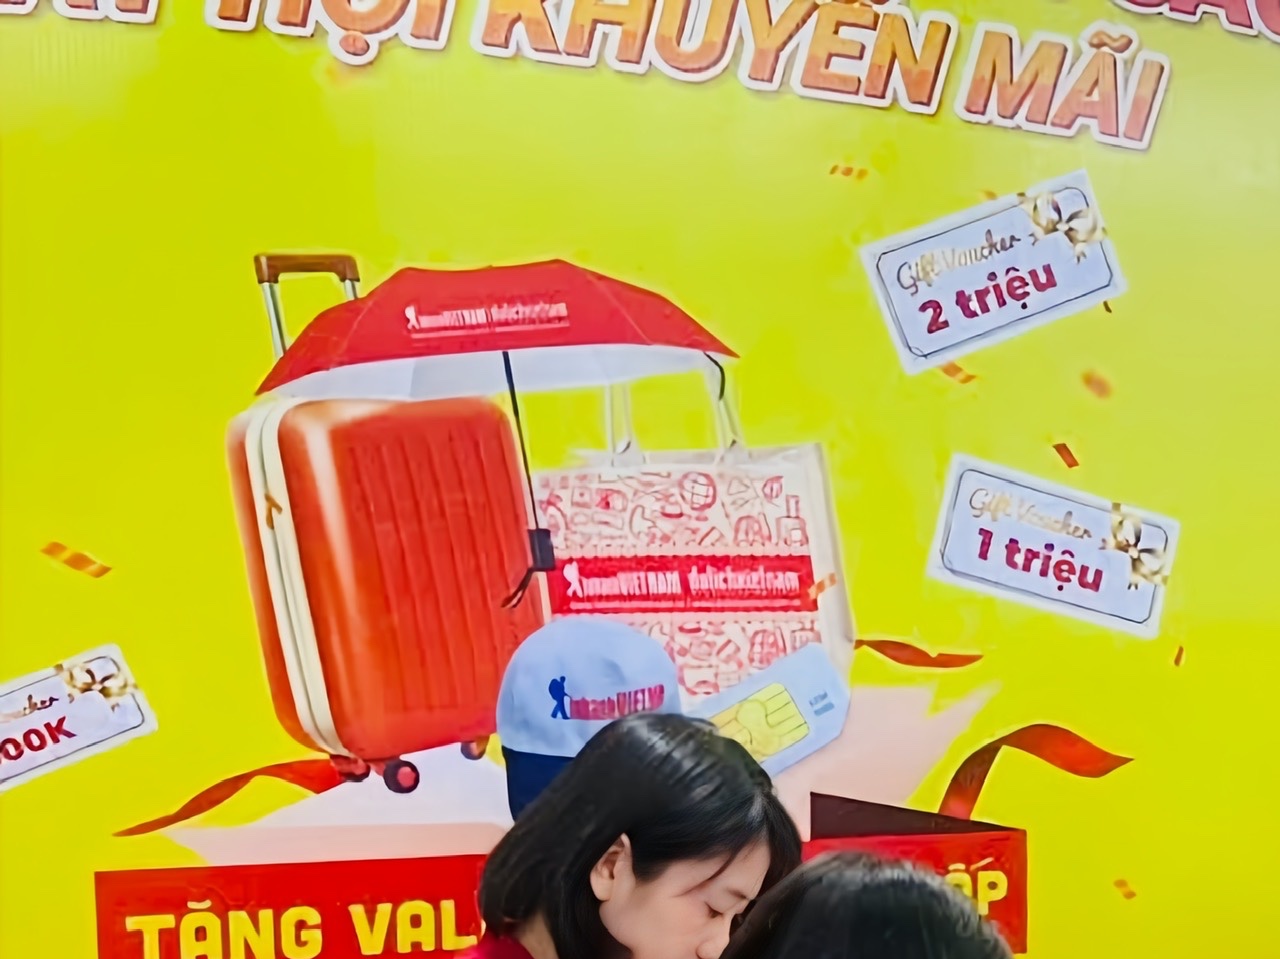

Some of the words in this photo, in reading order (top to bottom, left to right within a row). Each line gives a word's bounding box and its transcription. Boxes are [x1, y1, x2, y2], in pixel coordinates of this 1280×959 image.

[963, 28, 1164, 142] MÃI
[919, 299, 949, 334] 2
[955, 263, 1058, 318] triệu
[977, 527, 994, 561] 1
[1004, 537, 1103, 593] triệu
[0, 716, 77, 765] 00K
